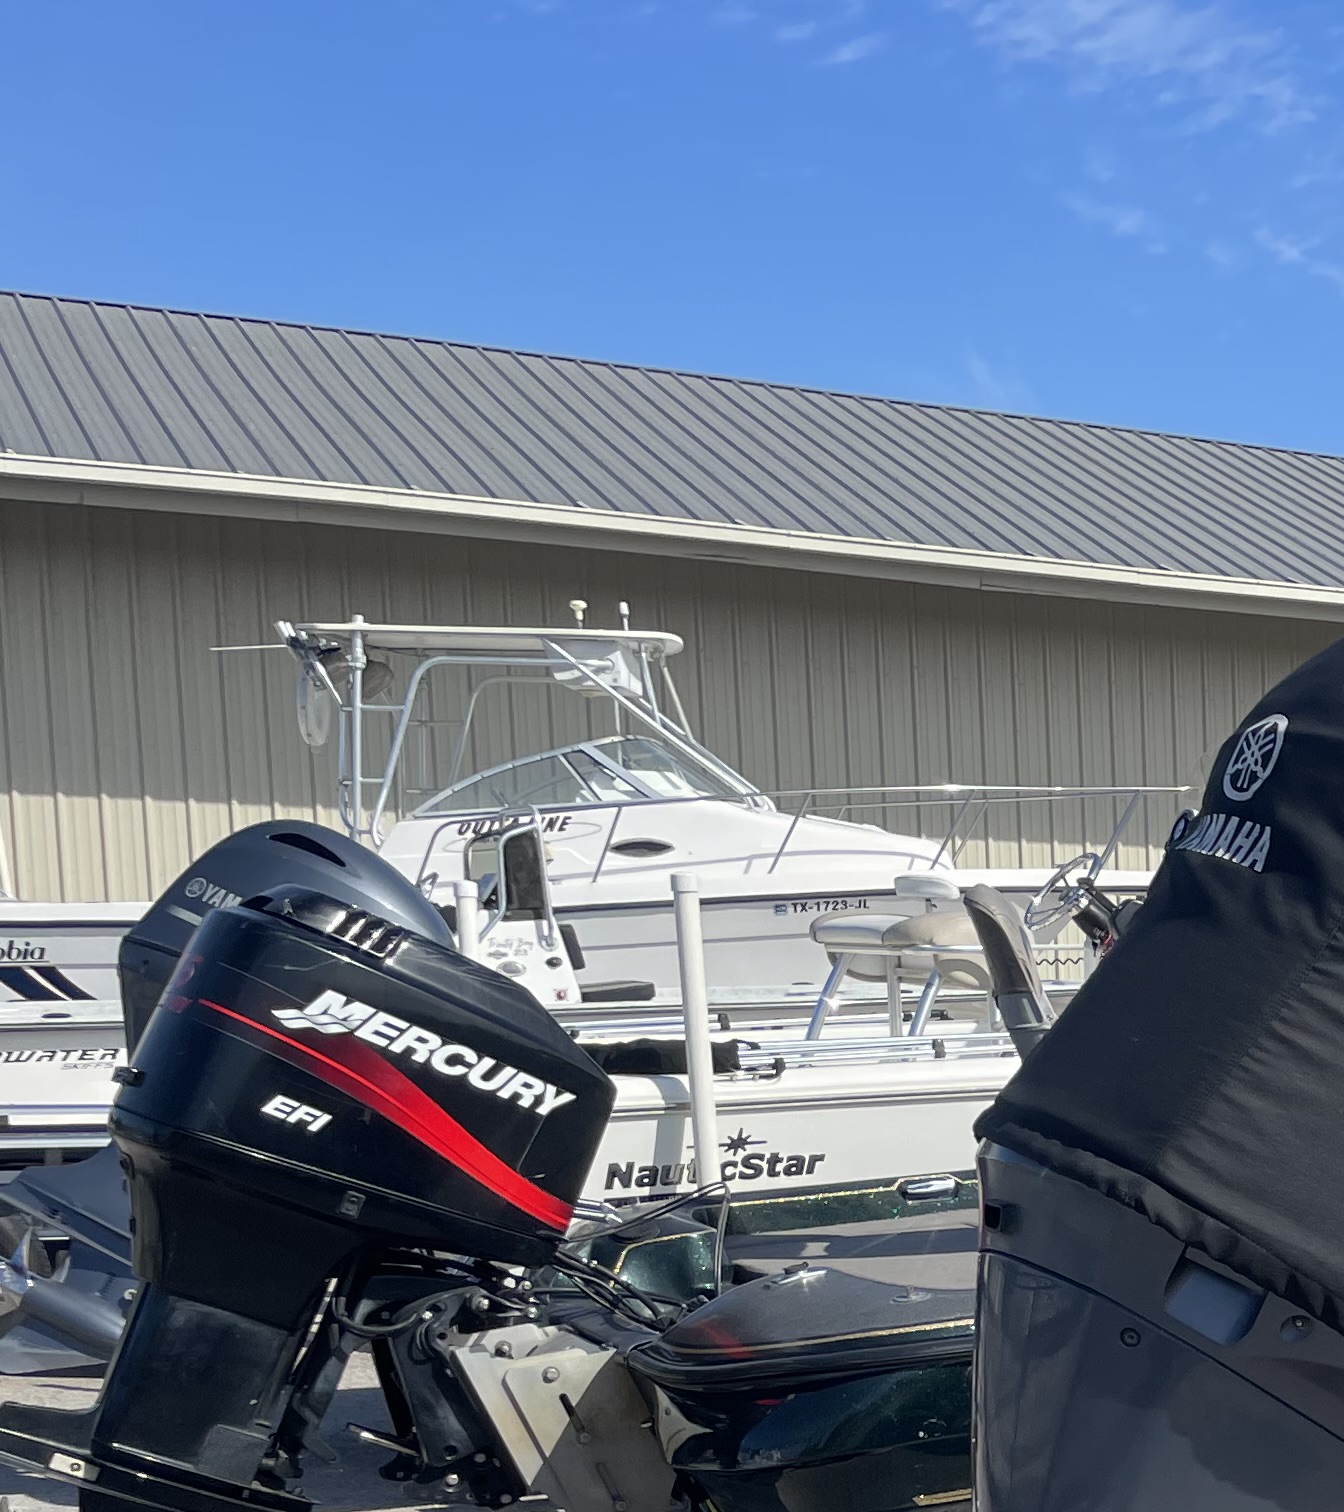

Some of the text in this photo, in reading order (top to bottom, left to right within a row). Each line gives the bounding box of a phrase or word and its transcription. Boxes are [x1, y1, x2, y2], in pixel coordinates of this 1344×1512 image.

[201, 883, 243, 909] YAM
[0, 1047, 120, 1064] WATER
[275, 988, 577, 1116] MERCURY
[260, 1094, 333, 1133] EFI
[604, 1151, 827, 1191] NautcStar
